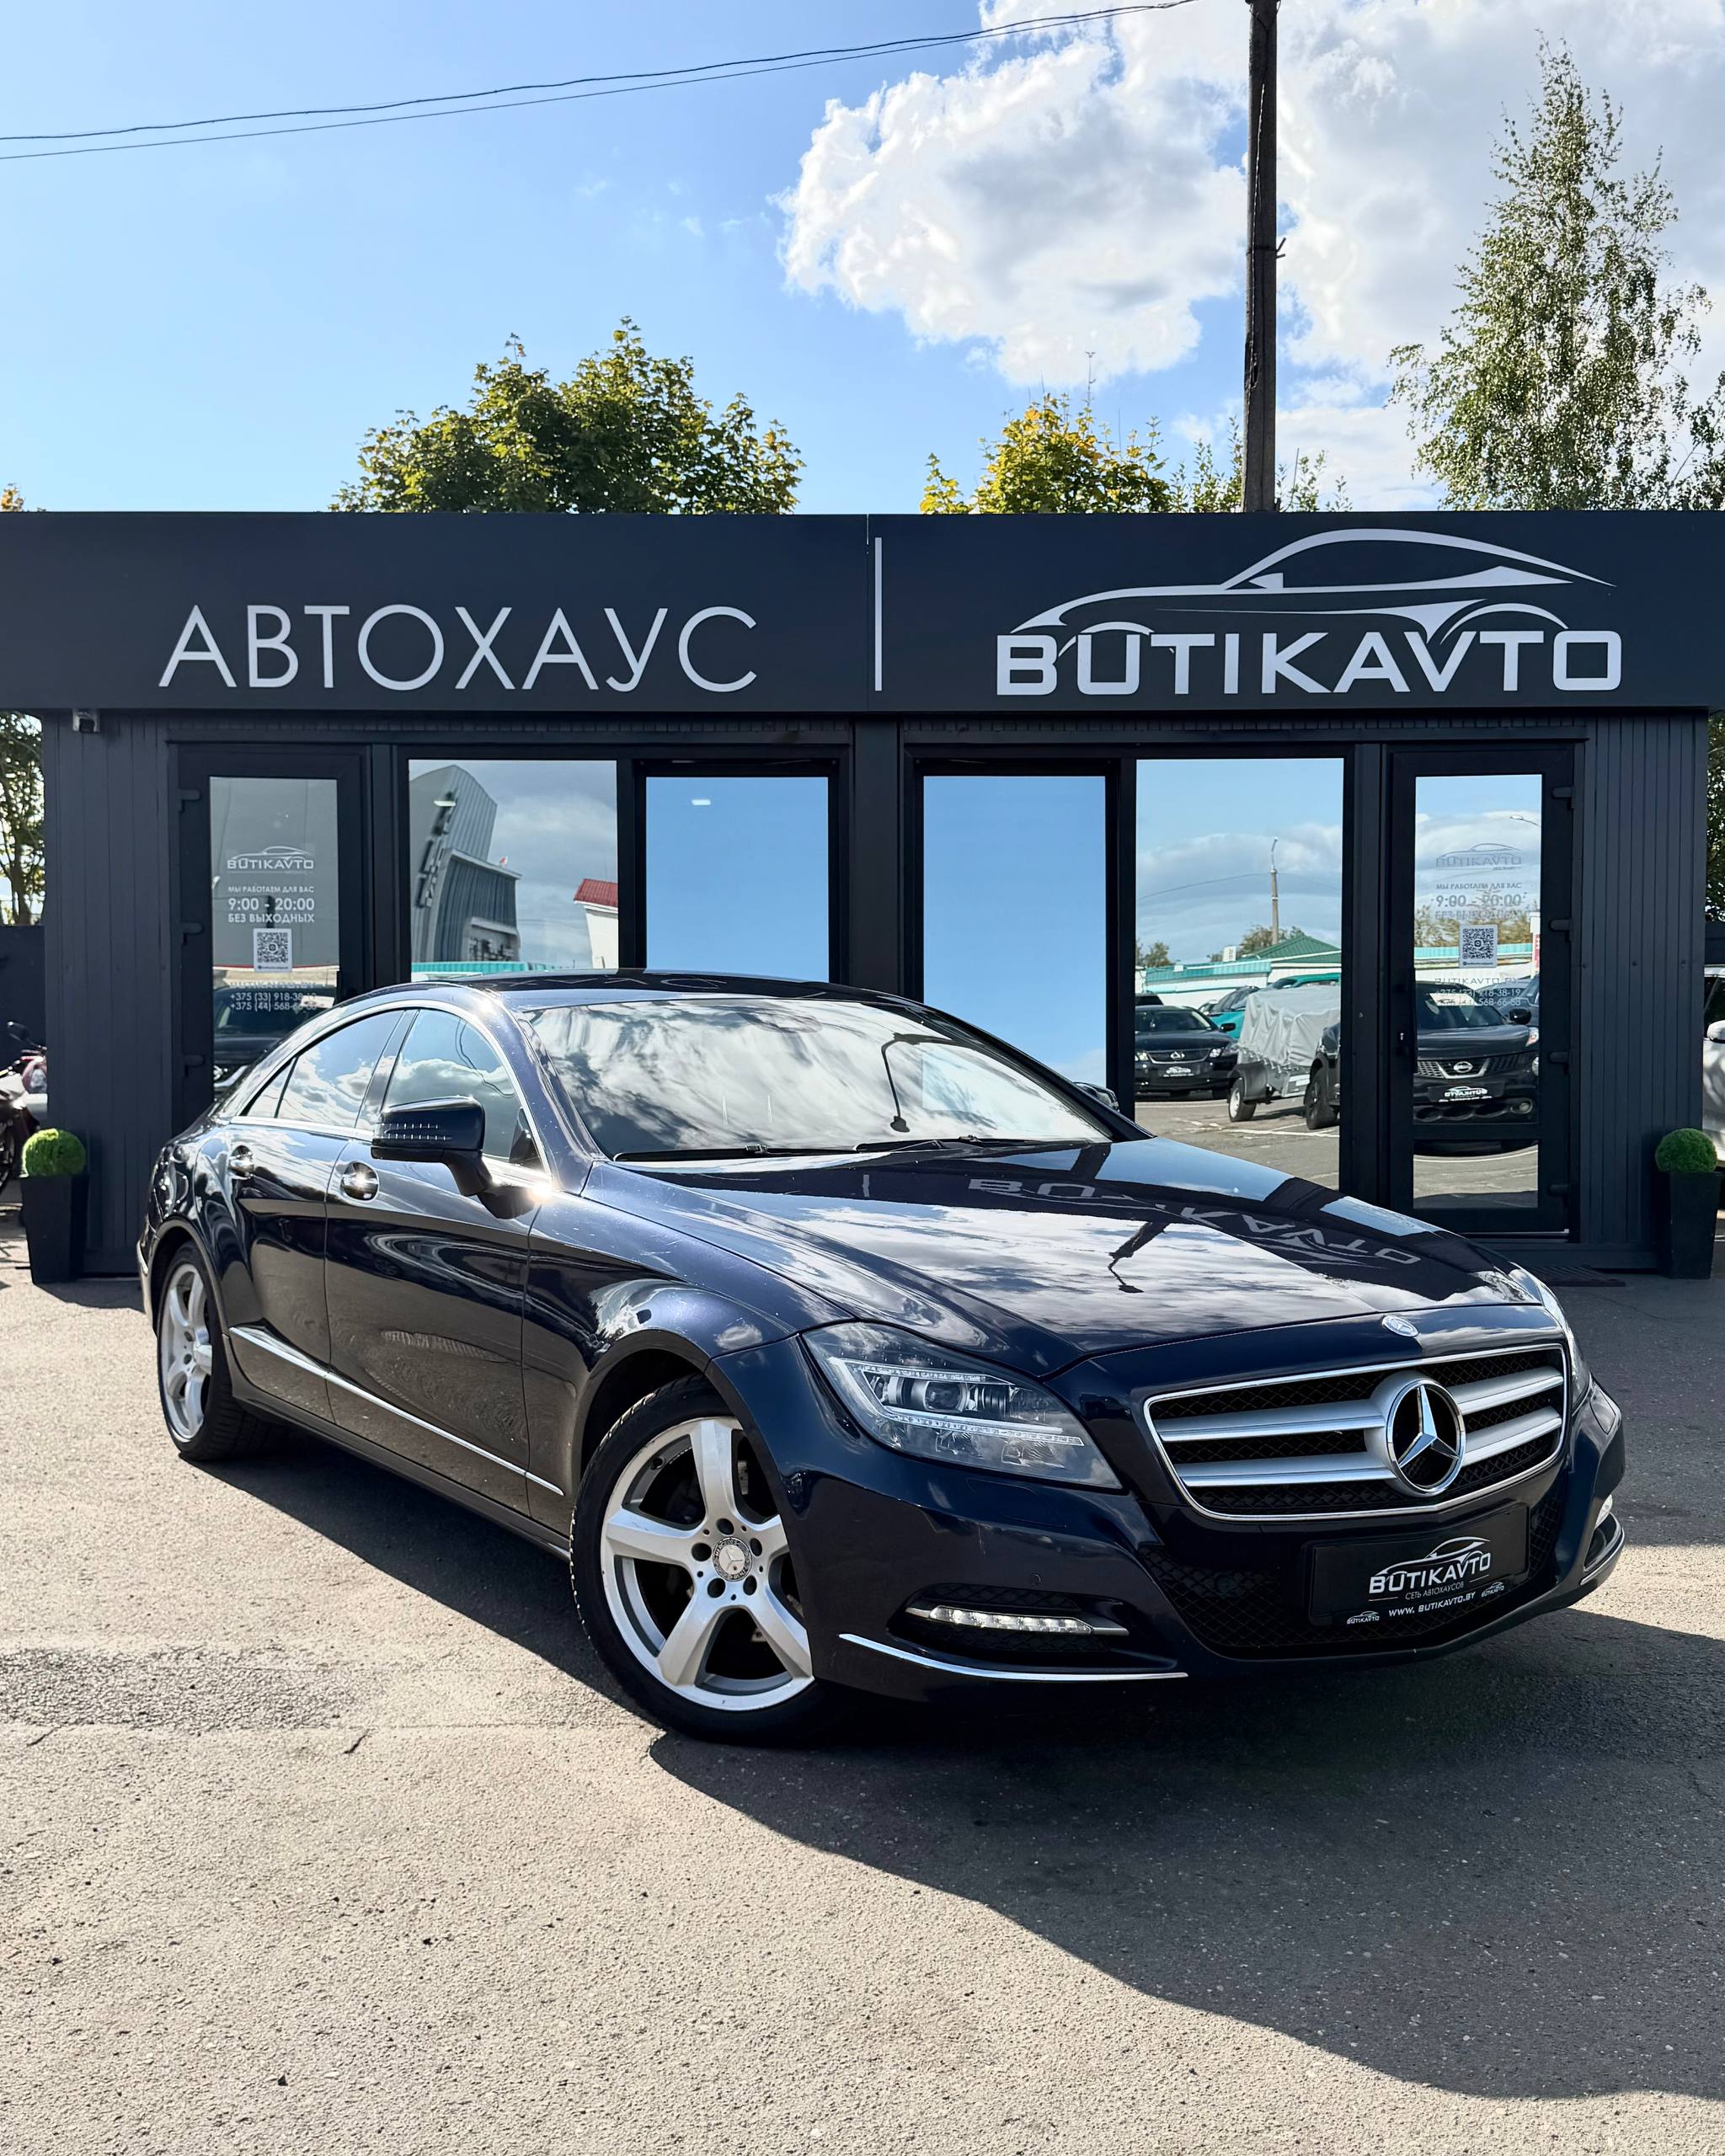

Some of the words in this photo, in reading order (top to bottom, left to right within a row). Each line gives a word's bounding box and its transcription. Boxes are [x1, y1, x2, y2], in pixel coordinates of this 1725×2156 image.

[158, 604, 757, 693] АВТОХАУС
[996, 629, 1623, 696] BUTIKAVTO
[227, 858, 314, 870] BUTIKAVTO
[228, 898, 259, 910] 9:00
[275, 898, 315, 910] 20:00
[1436, 894, 1466, 907] 9:00
[228, 913, 246, 923] БЕЗ
[249, 913, 315, 924] ВЫХОДНЫХ
[230, 992, 253, 1001] +375
[254, 992, 271, 1002] (33)
[230, 1001, 253, 1011] +375
[254, 1001, 271, 1011] (44)
[1368, 1552, 1491, 1594] BUTIKAVTO
[1405, 1591, 1422, 1600] СЕТЬ
[1423, 1581, 1464, 1597] АВТОХАУСОВ
[1388, 1606, 1415, 1617] WWW.
[1418, 1591, 1476, 1613] BUTIKAVTO.BY
